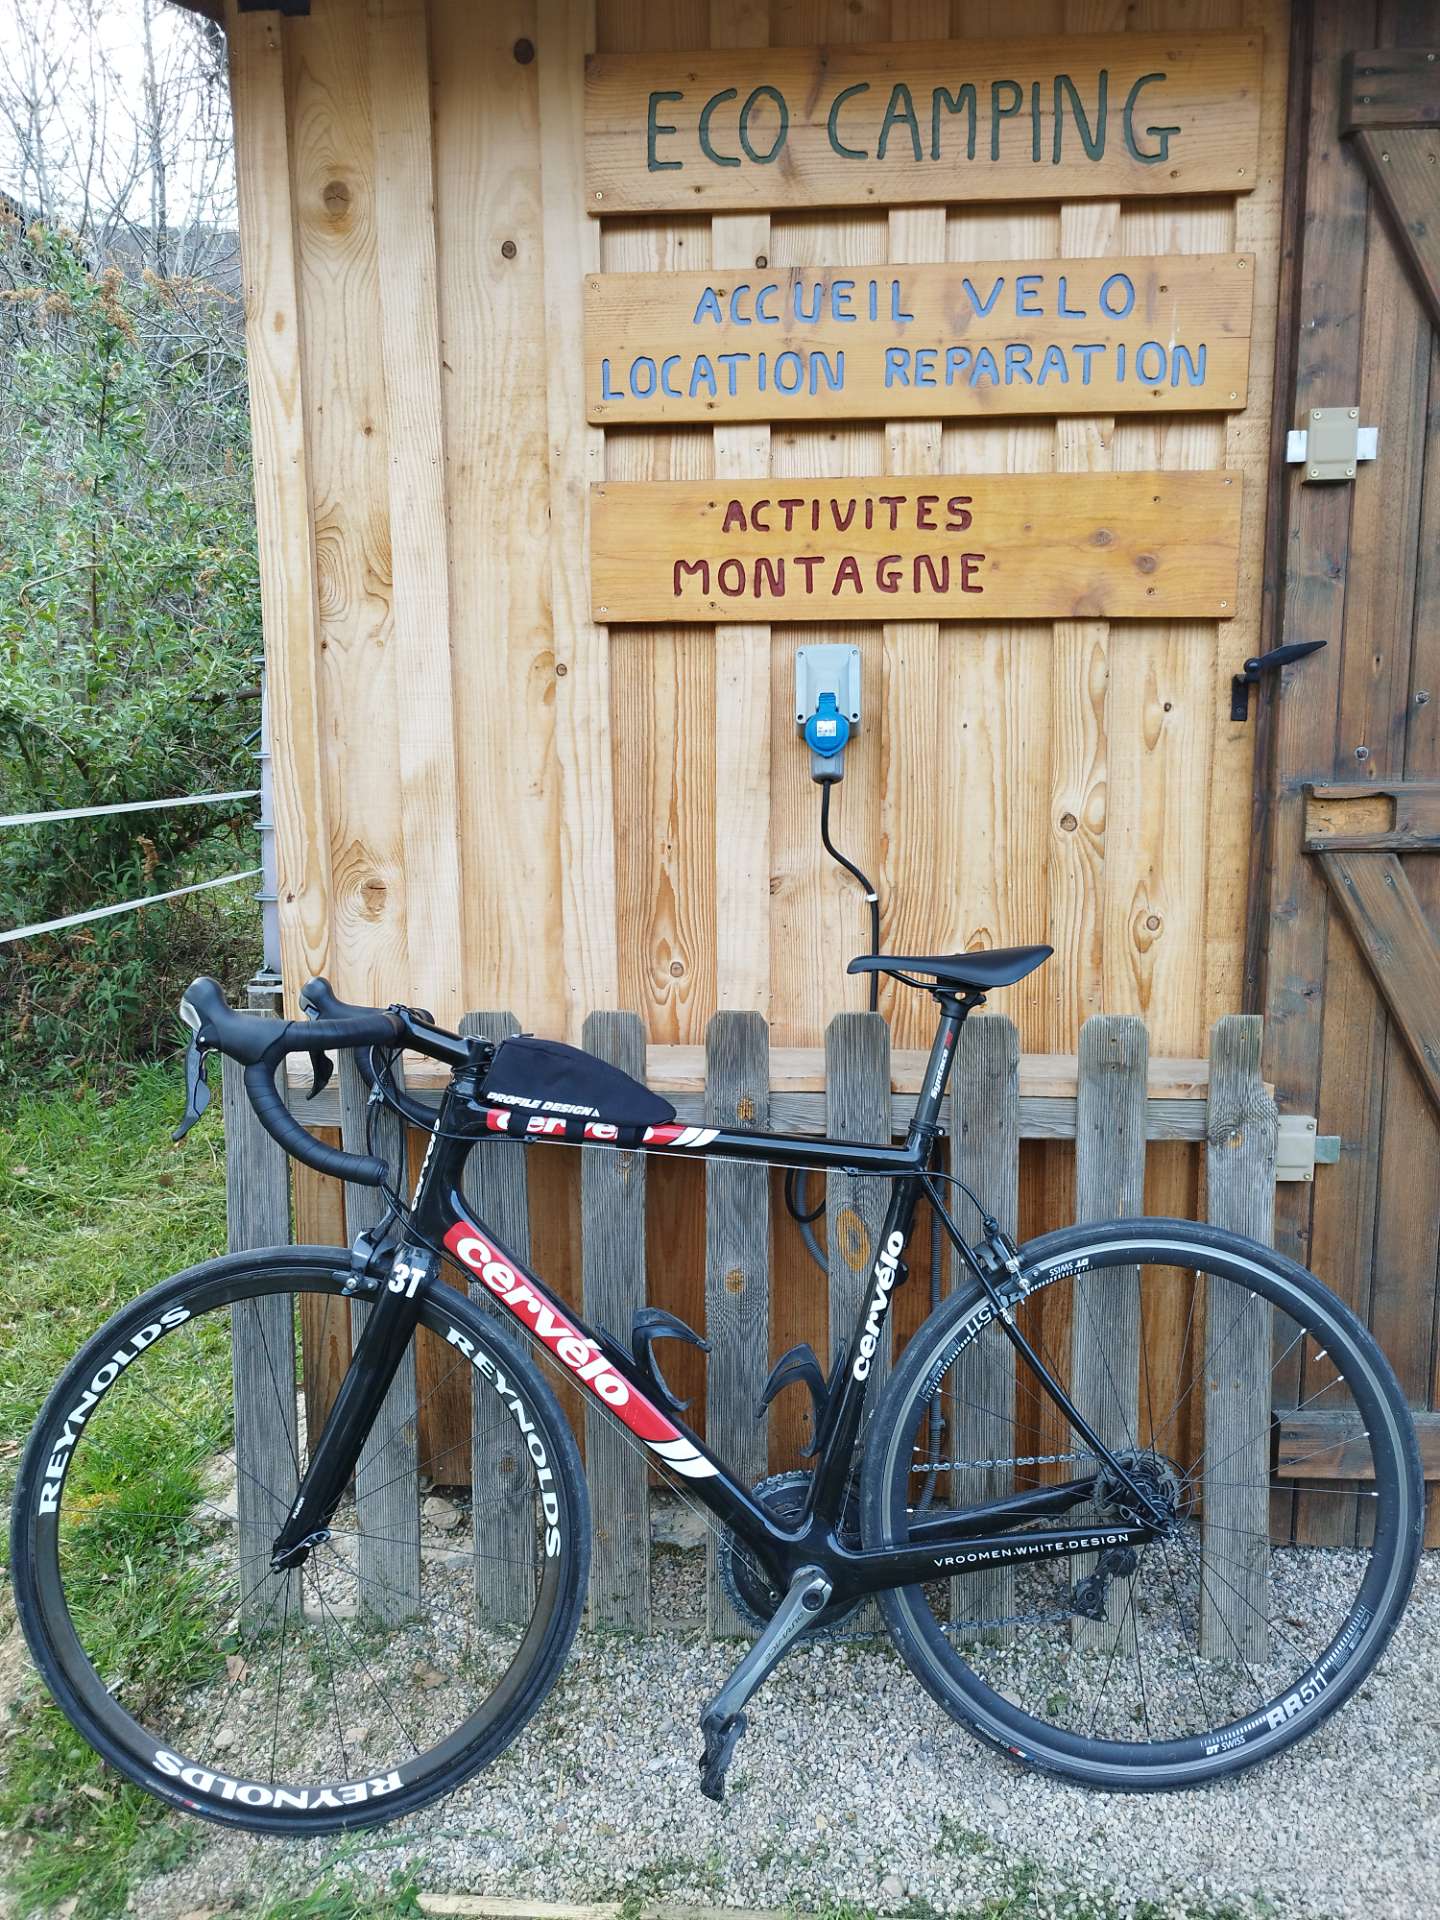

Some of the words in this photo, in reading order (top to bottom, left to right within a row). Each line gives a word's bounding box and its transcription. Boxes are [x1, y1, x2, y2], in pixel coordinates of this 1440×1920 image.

[647, 84, 789, 172] ECO
[827, 69, 1182, 165] CAMPING
[693, 278, 914, 325] ACCUEIL
[962, 272, 1136, 320] VELO
[602, 349, 845, 401] LOCATION
[884, 341, 1207, 388] REPARATION
[721, 494, 974, 533] ACTIVITES
[672, 552, 987, 599] MONTAGNE
[486, 1091, 542, 1109] PROFILE
[541, 1101, 595, 1117] DESIGN
[387, 1263, 427, 1299] 3T
[1049, 1261, 1074, 1277] SWISS
[37, 1304, 192, 1517] REYNOLDS
[445, 1324, 562, 1559] REYNOLDS
[1221, 1735, 1246, 1751] SWISS
[152, 1749, 404, 1810] REYNOLDS
